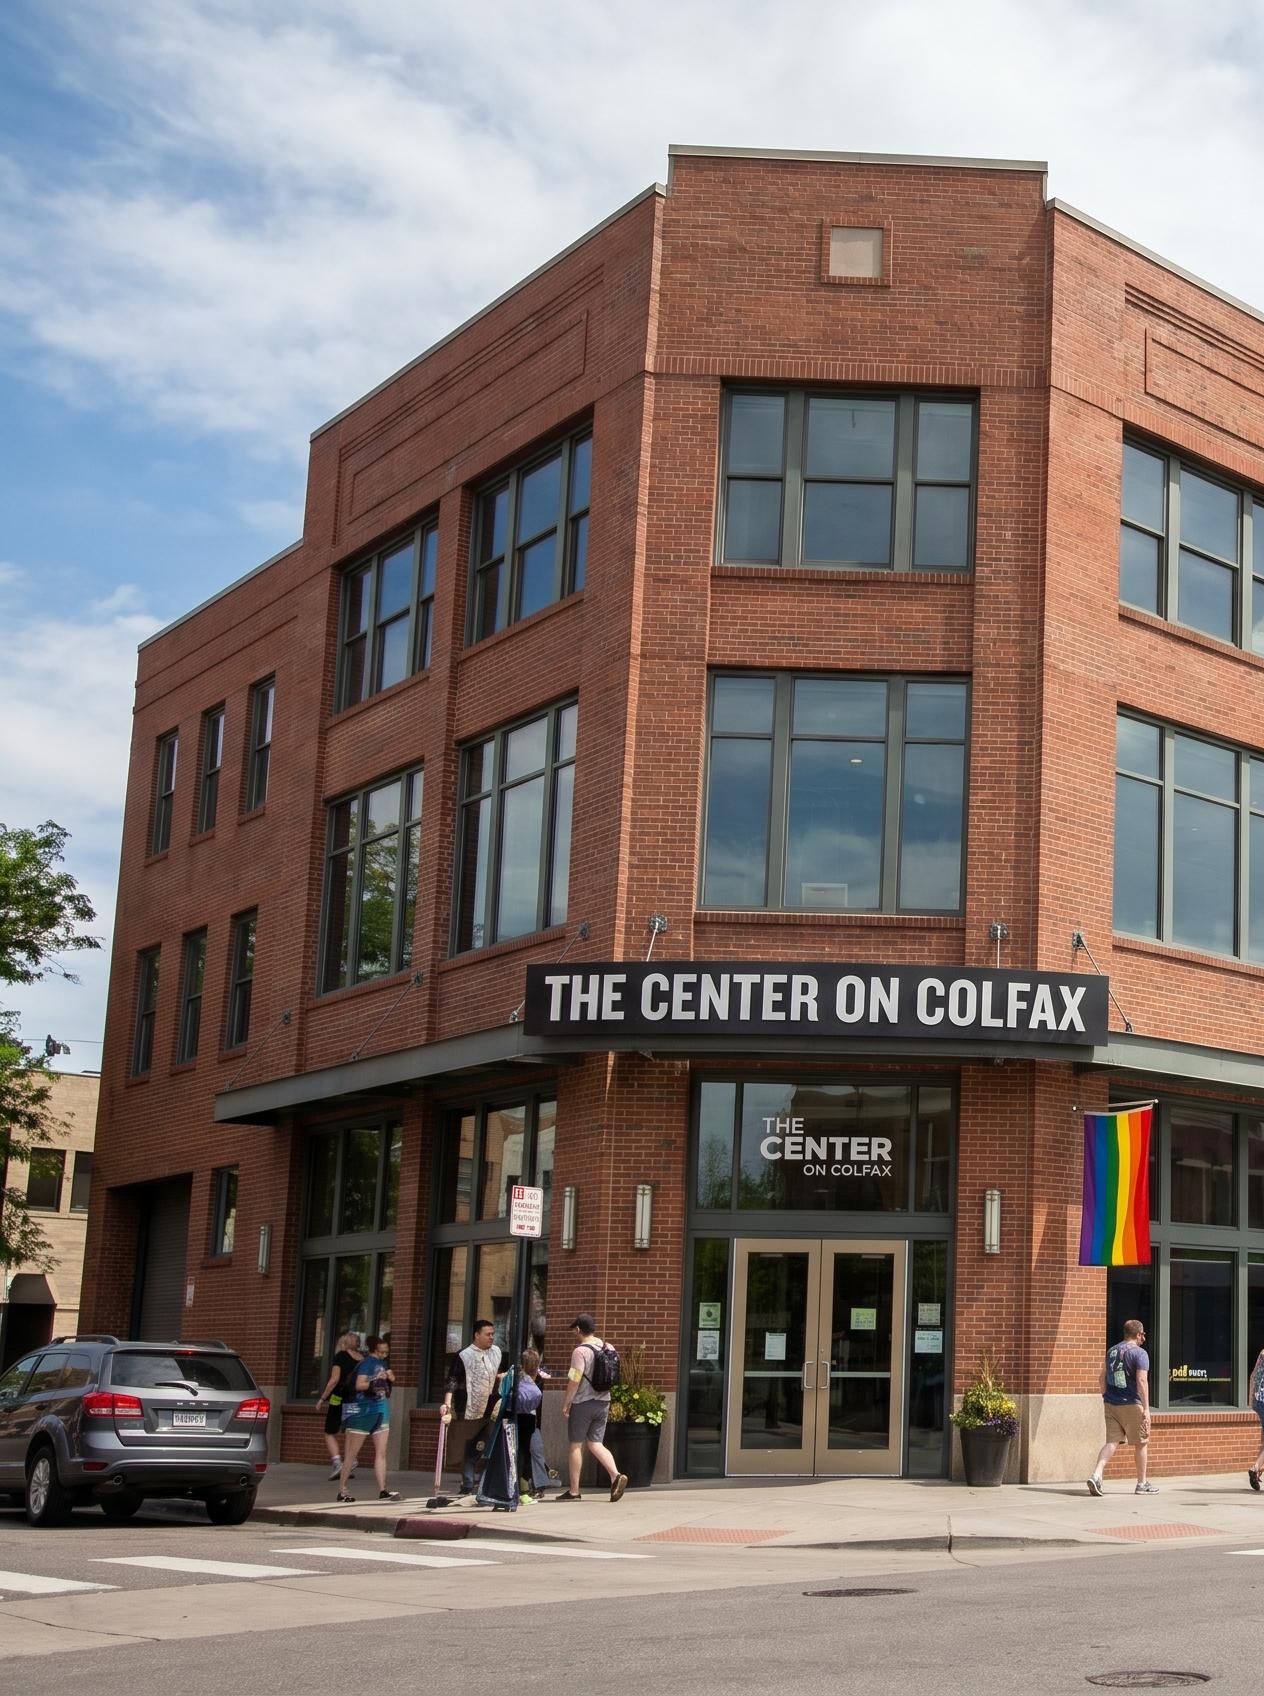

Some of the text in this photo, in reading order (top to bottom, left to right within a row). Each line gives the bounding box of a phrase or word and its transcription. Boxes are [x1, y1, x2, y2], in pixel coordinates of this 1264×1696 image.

[544, 973, 1087, 1032] THE CENTER ON COLFAX
[762, 1117, 805, 1134] THE
[760, 1136, 892, 1161] CENTER
[803, 1164, 892, 1177] ON COLFAX
